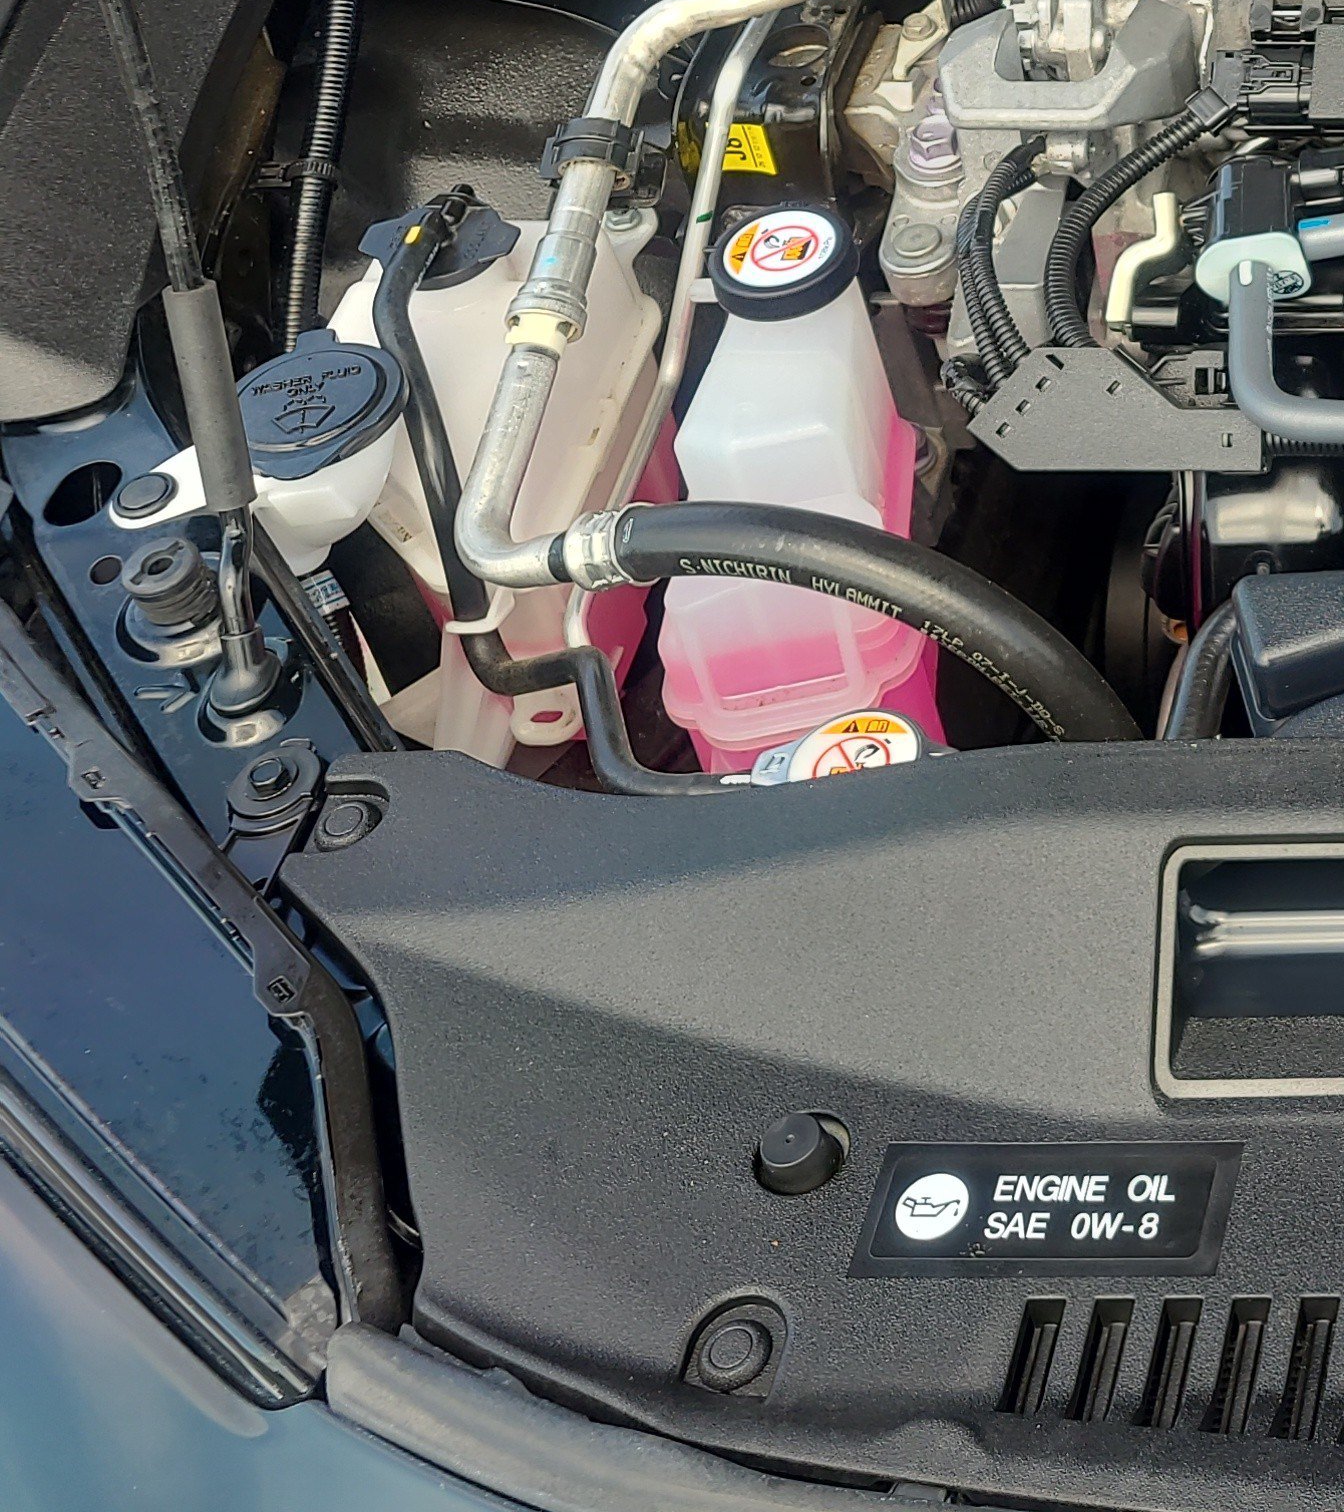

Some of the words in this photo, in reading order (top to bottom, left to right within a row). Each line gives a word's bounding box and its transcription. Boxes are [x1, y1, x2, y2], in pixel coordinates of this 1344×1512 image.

[993, 1175, 1109, 1203] ENGINE
[1127, 1175, 1175, 1203] OIL
[983, 1211, 1050, 1240] SAE
[1071, 1211, 1159, 1241] 0W-8
